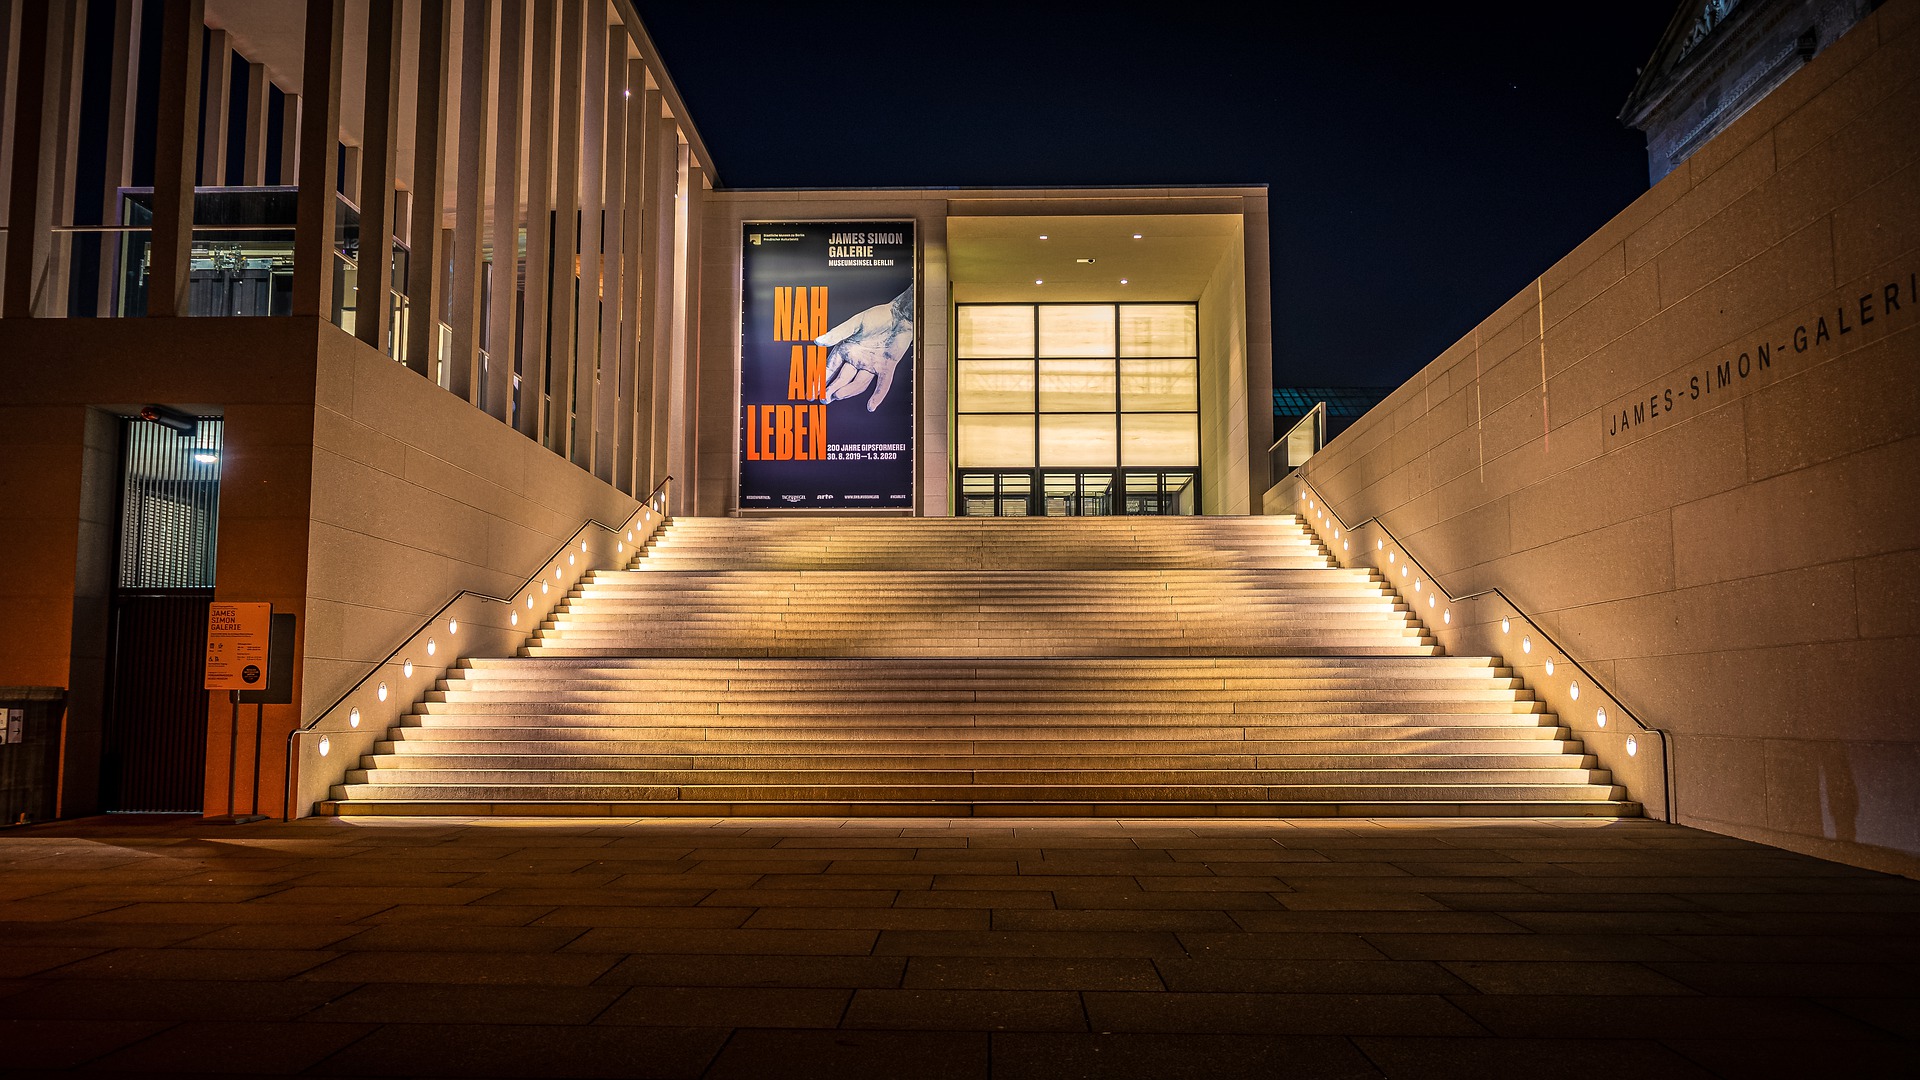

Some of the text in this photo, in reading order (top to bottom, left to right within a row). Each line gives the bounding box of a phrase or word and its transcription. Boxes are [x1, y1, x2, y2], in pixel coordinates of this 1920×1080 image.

[828, 232, 903, 245] JAMES SIMON
[828, 245, 874, 258] GALERIE
[828, 259, 873, 267] MUSEUMSINSEL
[773, 286, 828, 342] NAH
[787, 345, 827, 400] AM
[746, 404, 827, 461] LEBEN
[827, 444, 840, 452] 200
[861, 443, 906, 451] GIPSFORMEREI
[880, 452, 897, 460] 2020
